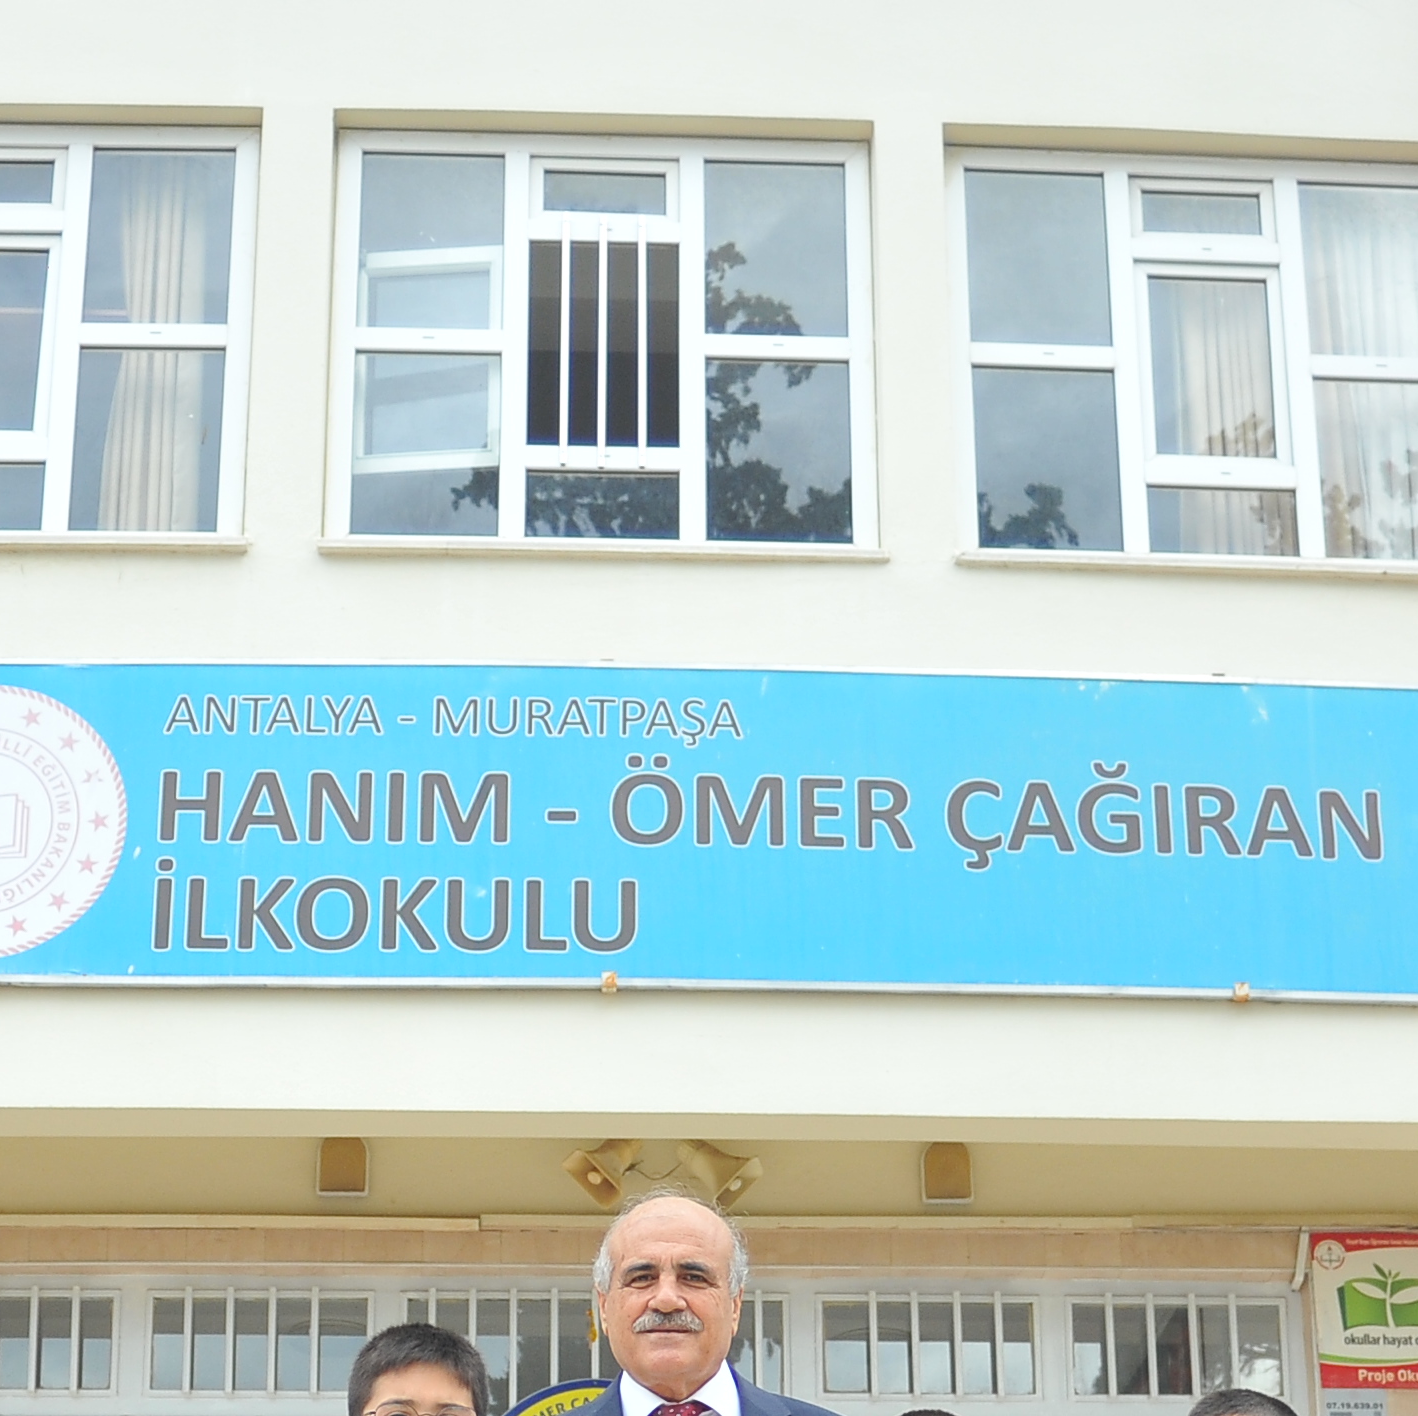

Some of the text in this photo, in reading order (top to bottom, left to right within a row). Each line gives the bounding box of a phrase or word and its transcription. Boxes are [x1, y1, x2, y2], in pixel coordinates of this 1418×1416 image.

[164, 696, 383, 734] ANTALYA
[433, 697, 743, 746] MURATPAŞA
[32, 754, 72, 815] EĞİTİM
[157, 770, 512, 844] HANIM
[610, 754, 914, 850] ÖMER
[946, 762, 1384, 871] ÇAĞIRAN
[152, 857, 638, 953] İLKOKULU
[1344, 1333, 1380, 1346] okullar
[1383, 1334, 1412, 1348] hayat
[1357, 1368, 1394, 1385] Proje
